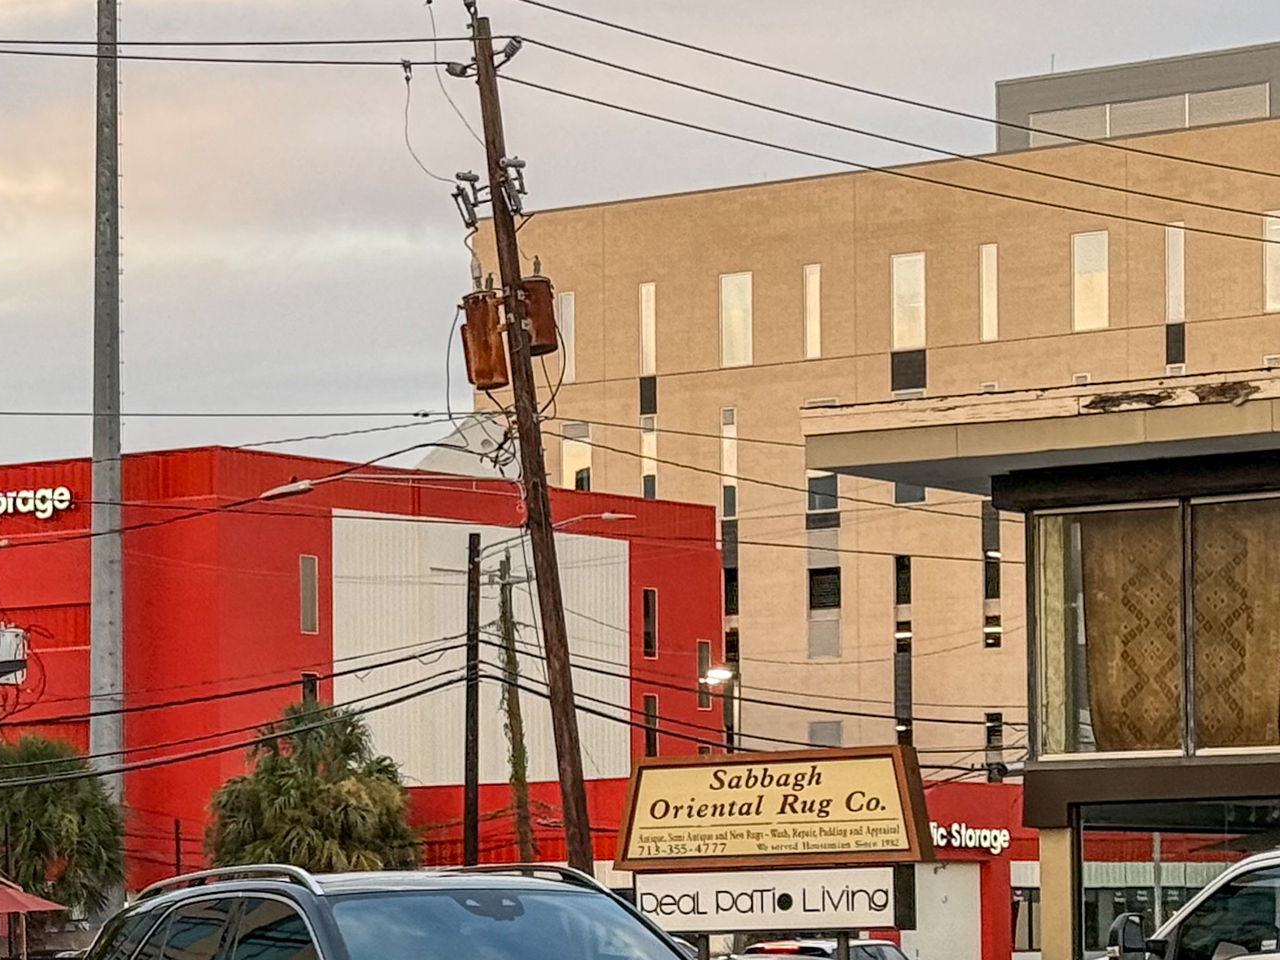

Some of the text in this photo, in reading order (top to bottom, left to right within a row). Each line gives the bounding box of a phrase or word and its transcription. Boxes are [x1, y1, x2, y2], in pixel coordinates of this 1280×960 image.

[709, 765, 823, 792] Sabbagh
[649, 790, 887, 820] Oriental Rug Co.
[715, 830, 728, 841] and
[849, 825, 864, 836] and
[950, 822, 1010, 855] Storage
[638, 842, 728, 856] 713-355-4777
